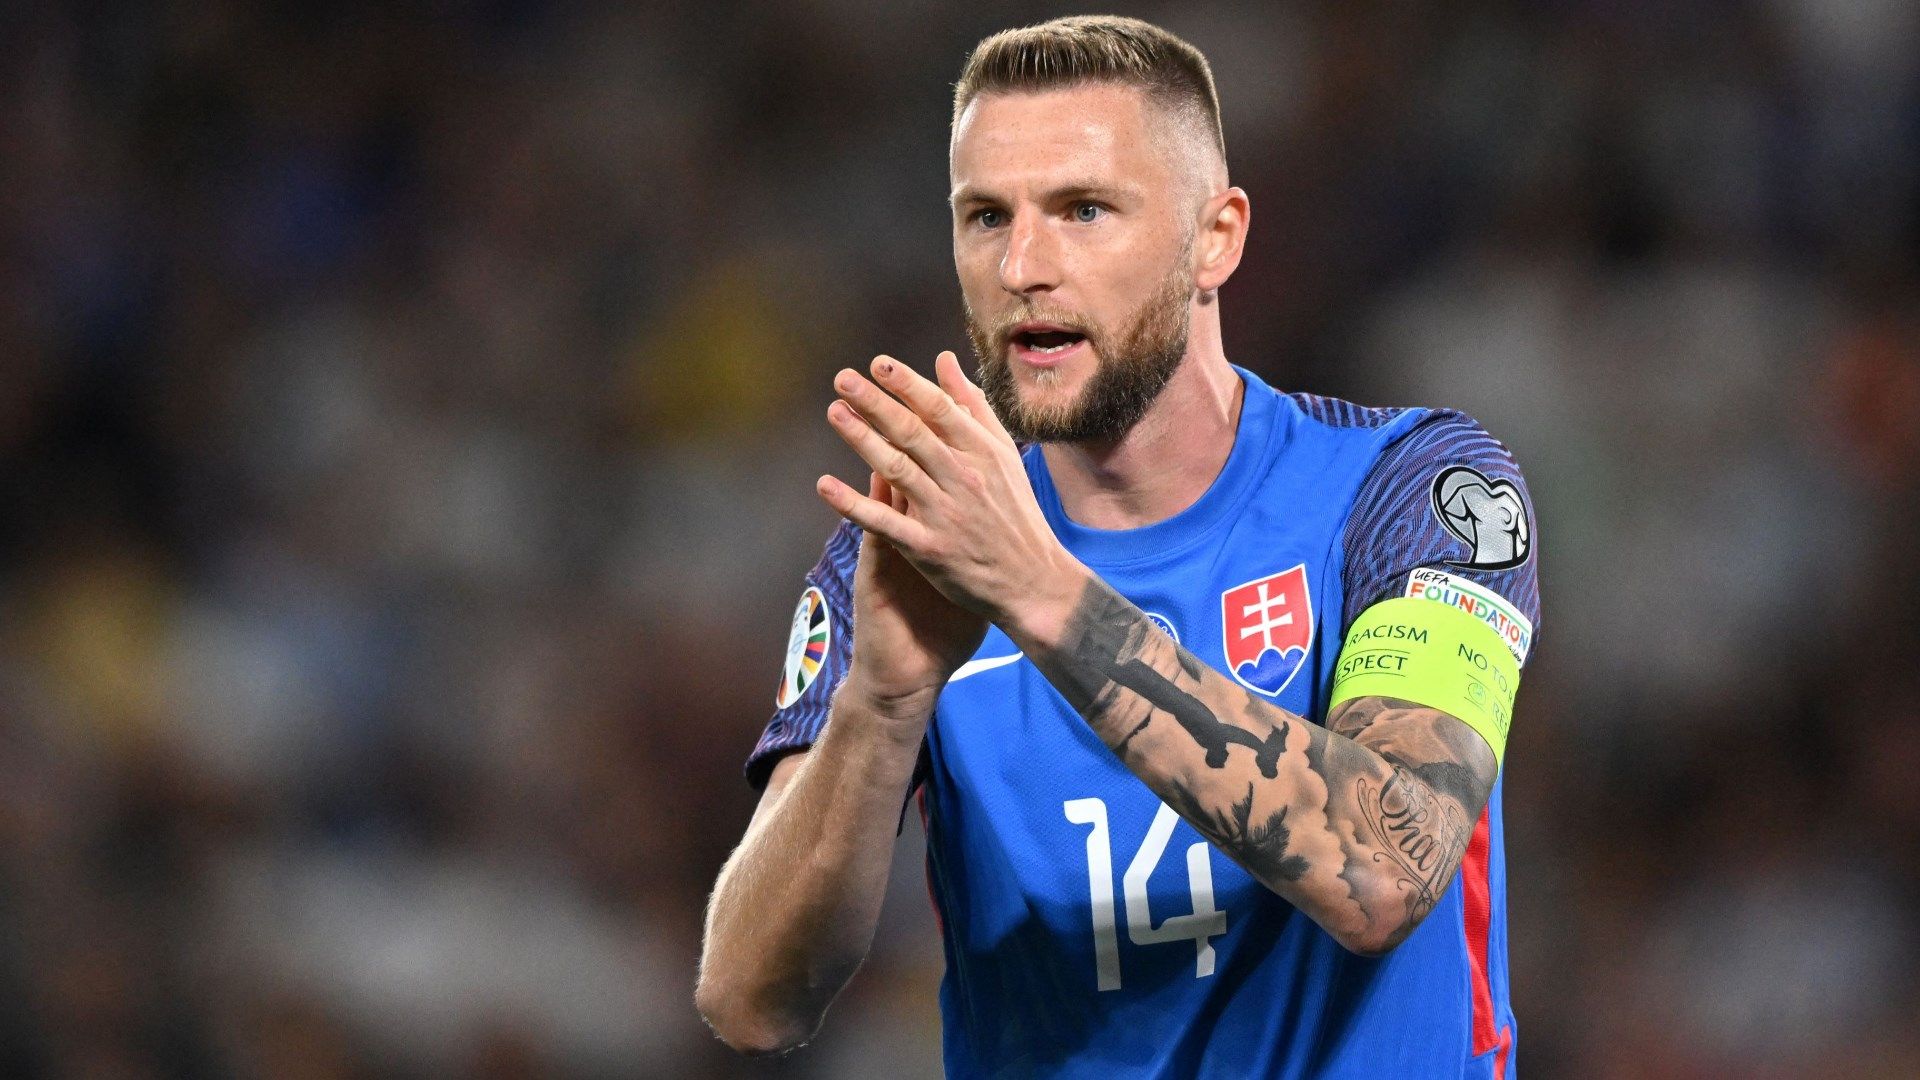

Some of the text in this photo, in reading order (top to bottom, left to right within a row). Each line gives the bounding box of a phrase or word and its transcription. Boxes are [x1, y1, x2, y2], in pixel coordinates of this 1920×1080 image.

[1414, 569, 1450, 586] UEFA
[1348, 624, 1428, 648] RACISM
[1409, 581, 1529, 652] FOUNDATION
[1335, 654, 1409, 685] ESPECT
[1457, 642, 1488, 671] NO
[1491, 664, 1508, 693] TO
[1063, 797, 1227, 992] 14
